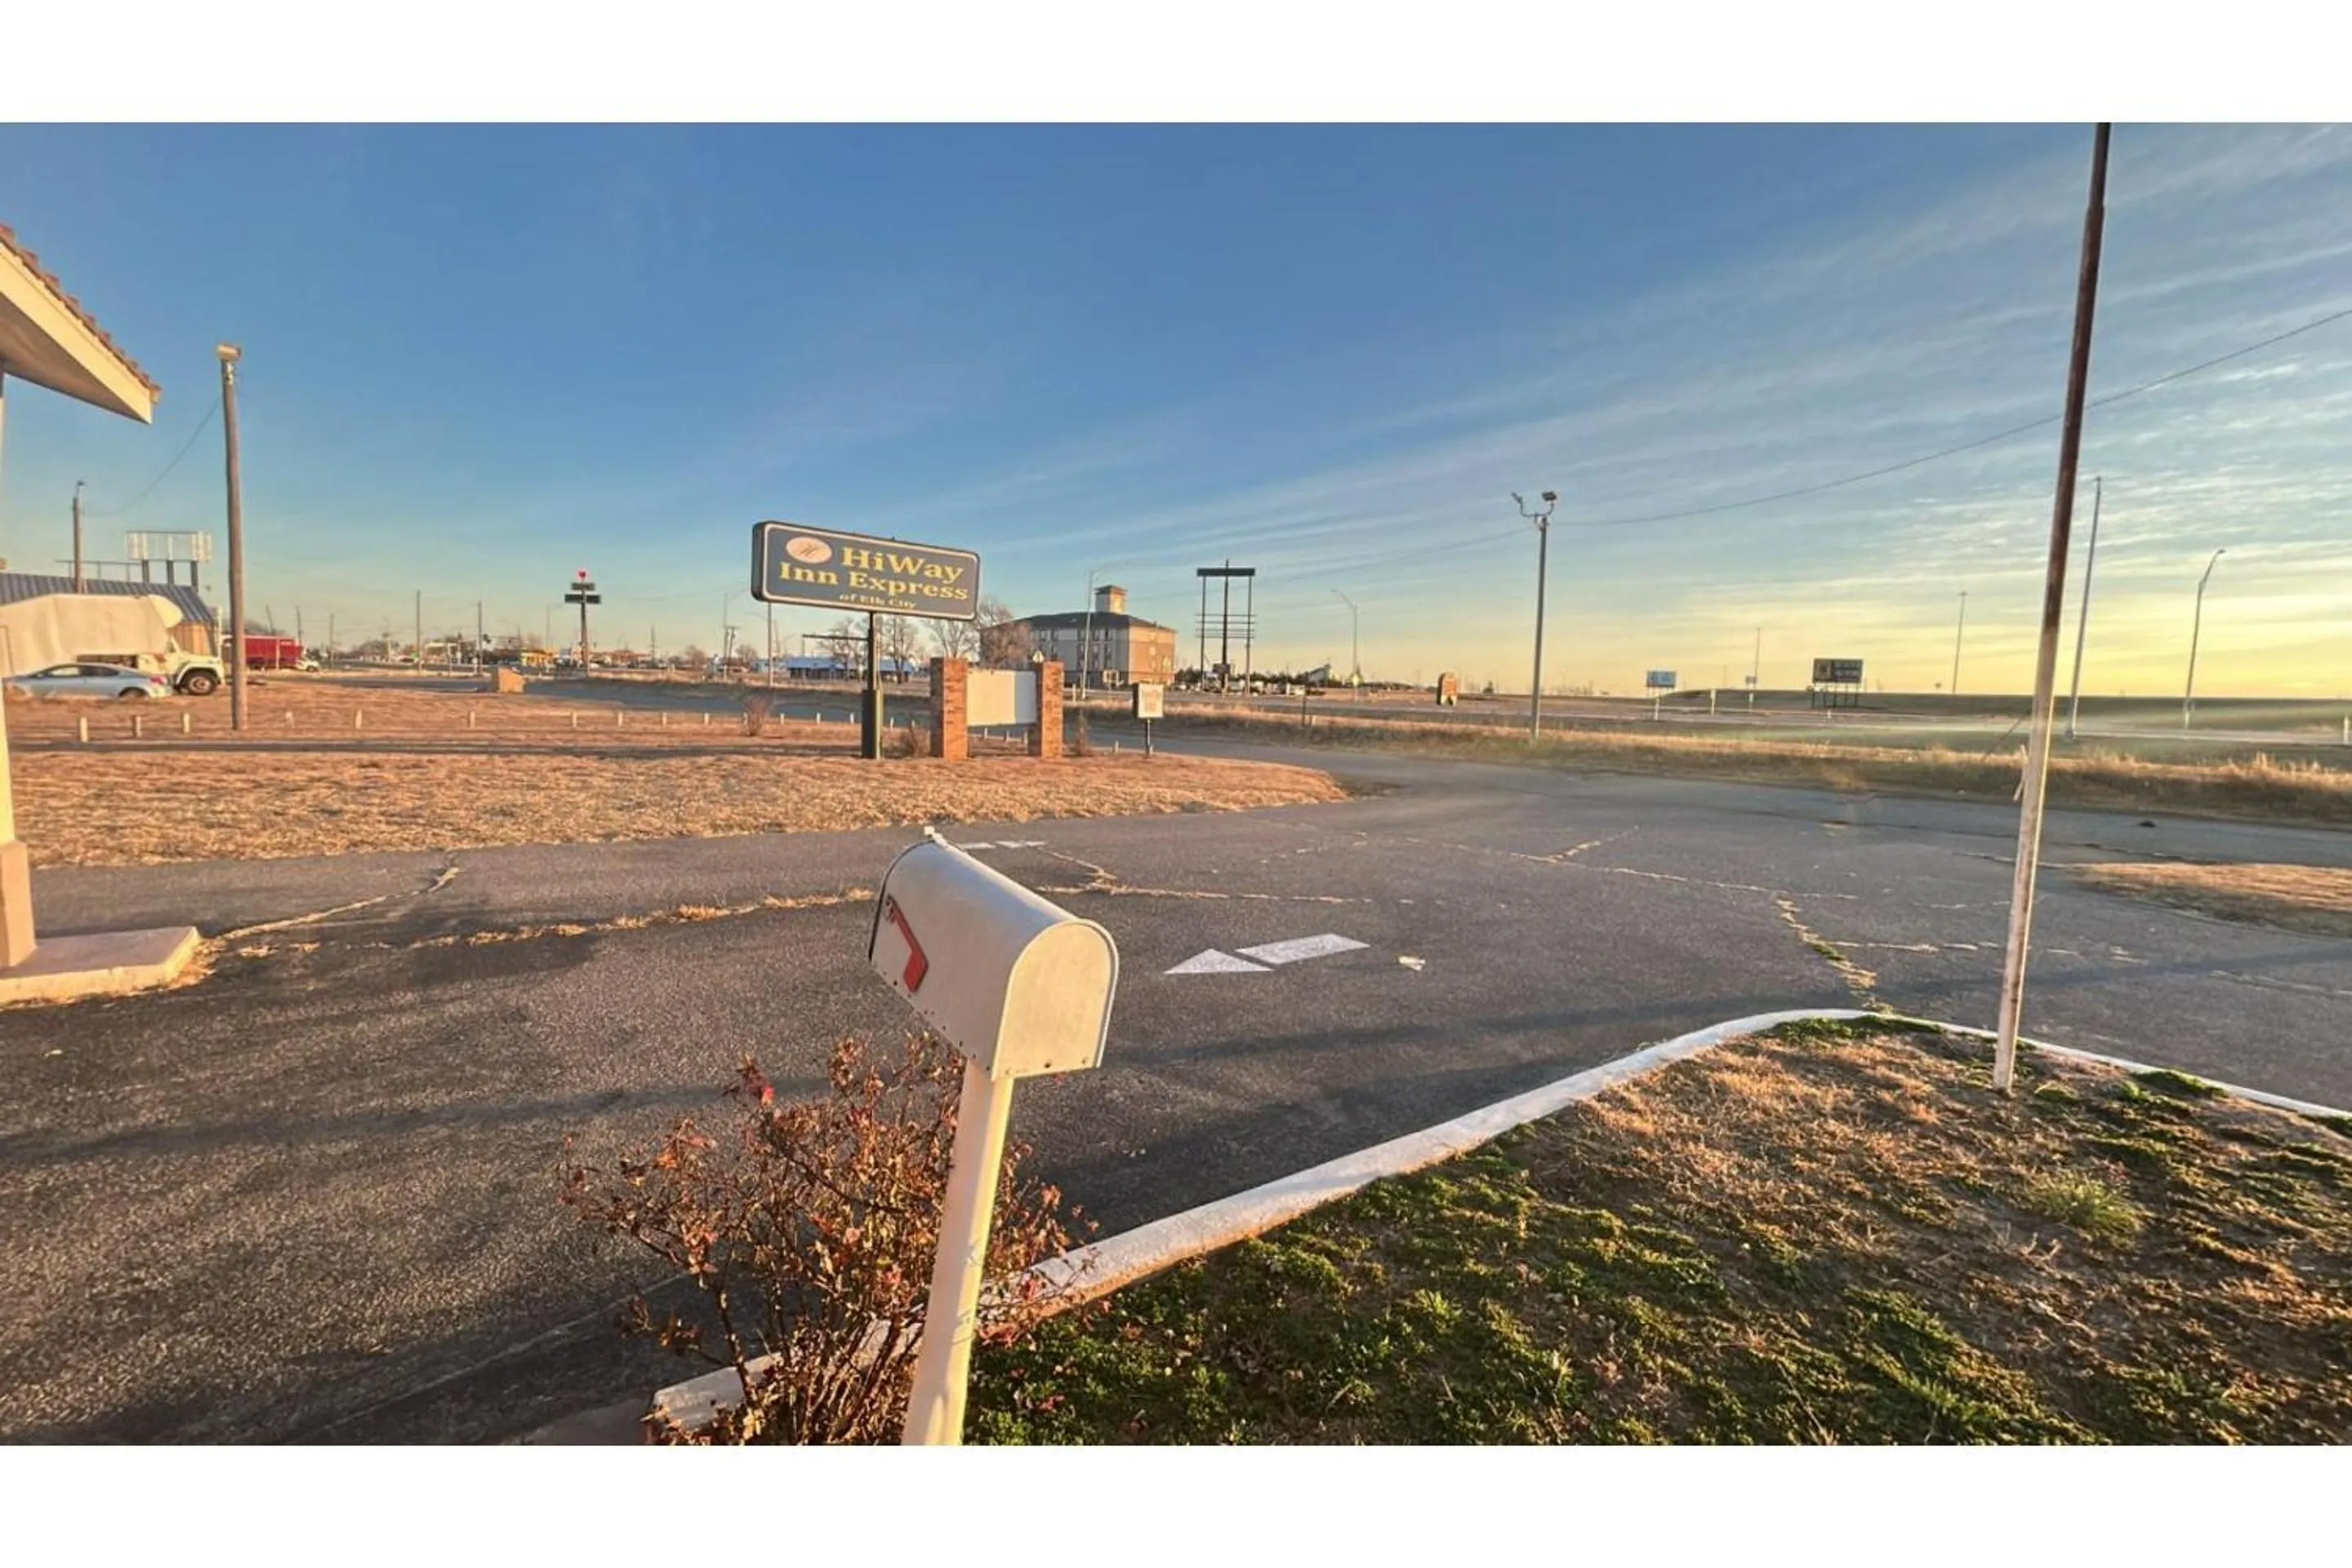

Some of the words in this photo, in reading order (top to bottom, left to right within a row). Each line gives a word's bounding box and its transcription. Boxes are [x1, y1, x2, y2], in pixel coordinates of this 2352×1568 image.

[779, 561, 838, 586] Inn
[849, 571, 969, 600] Express
[841, 546, 964, 584] HiWay
